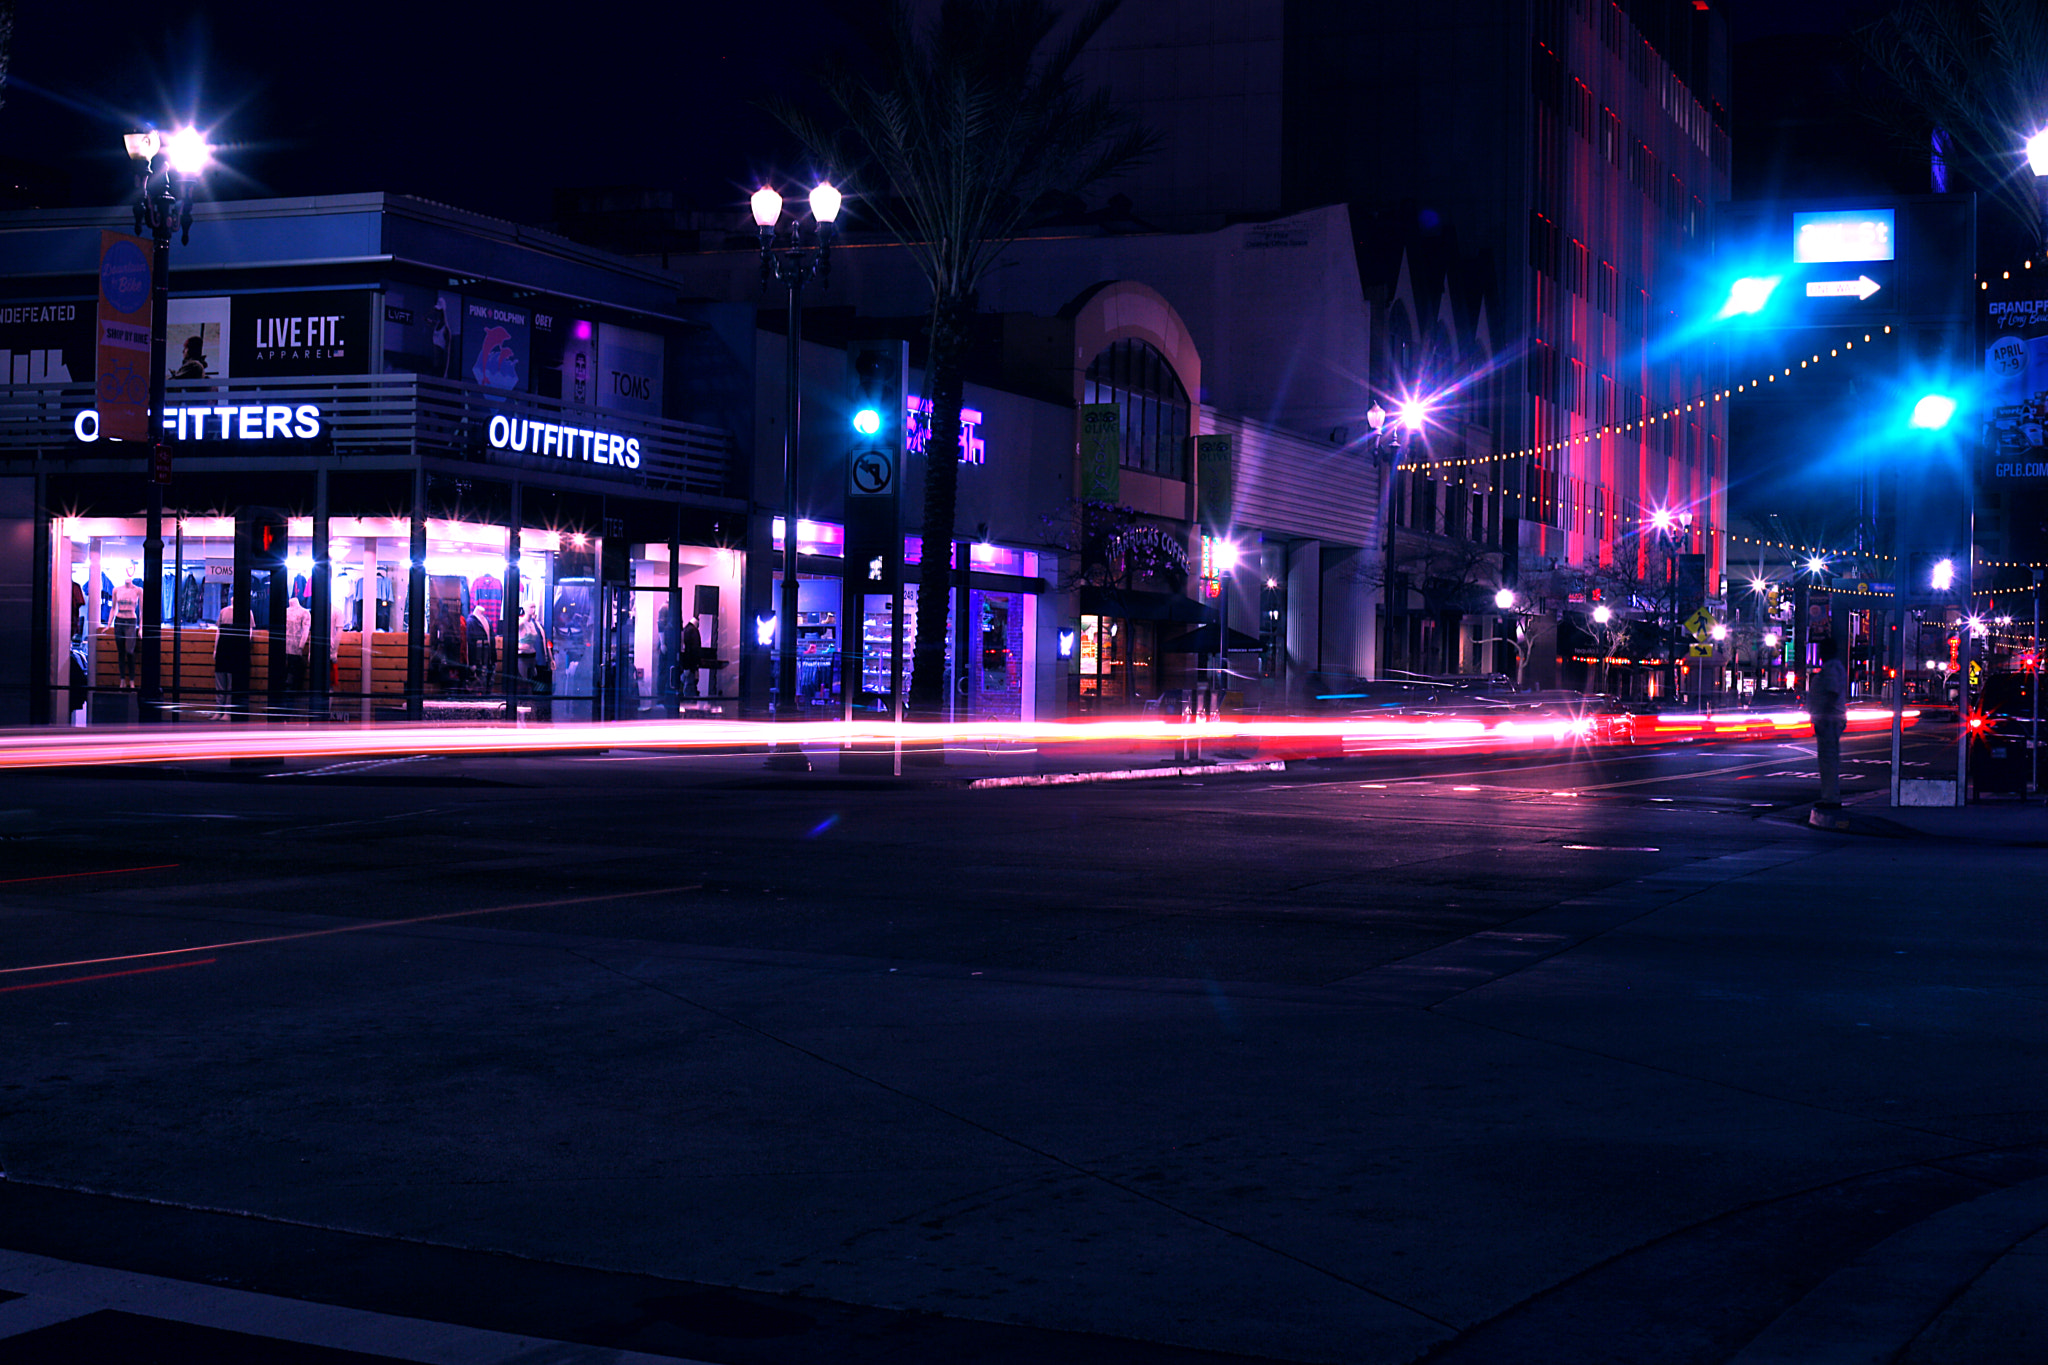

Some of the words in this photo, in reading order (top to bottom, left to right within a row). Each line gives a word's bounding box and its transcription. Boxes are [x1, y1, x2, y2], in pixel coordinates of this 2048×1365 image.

[469, 304, 489, 319] PINK
[493, 309, 525, 325] DOLPHIN
[1989, 301, 2033, 315] GRAND
[535, 313, 553, 328] OBEY
[106, 327, 123, 340] SHOP
[125, 331, 132, 341] BY
[133, 332, 149, 345] BIKE
[256, 317, 302, 348] LIVE
[256, 349, 332, 360] APPAREL
[1994, 343, 2024, 361] APRIL
[2001, 358, 2019, 372] 7-9
[611, 371, 650, 400] TOMS
[74, 405, 321, 442] OFITTERS
[1085, 422, 1117, 434] OLIVE
[488, 415, 641, 469] OUTFITTERS
[1200, 452, 1229, 463] OLIVE
[1996, 462, 2048, 478] GPLB.COM
[1161, 531, 1191, 577] COFFEE
[210, 566, 233, 576] TOMS
[903, 590, 914, 601] 248
